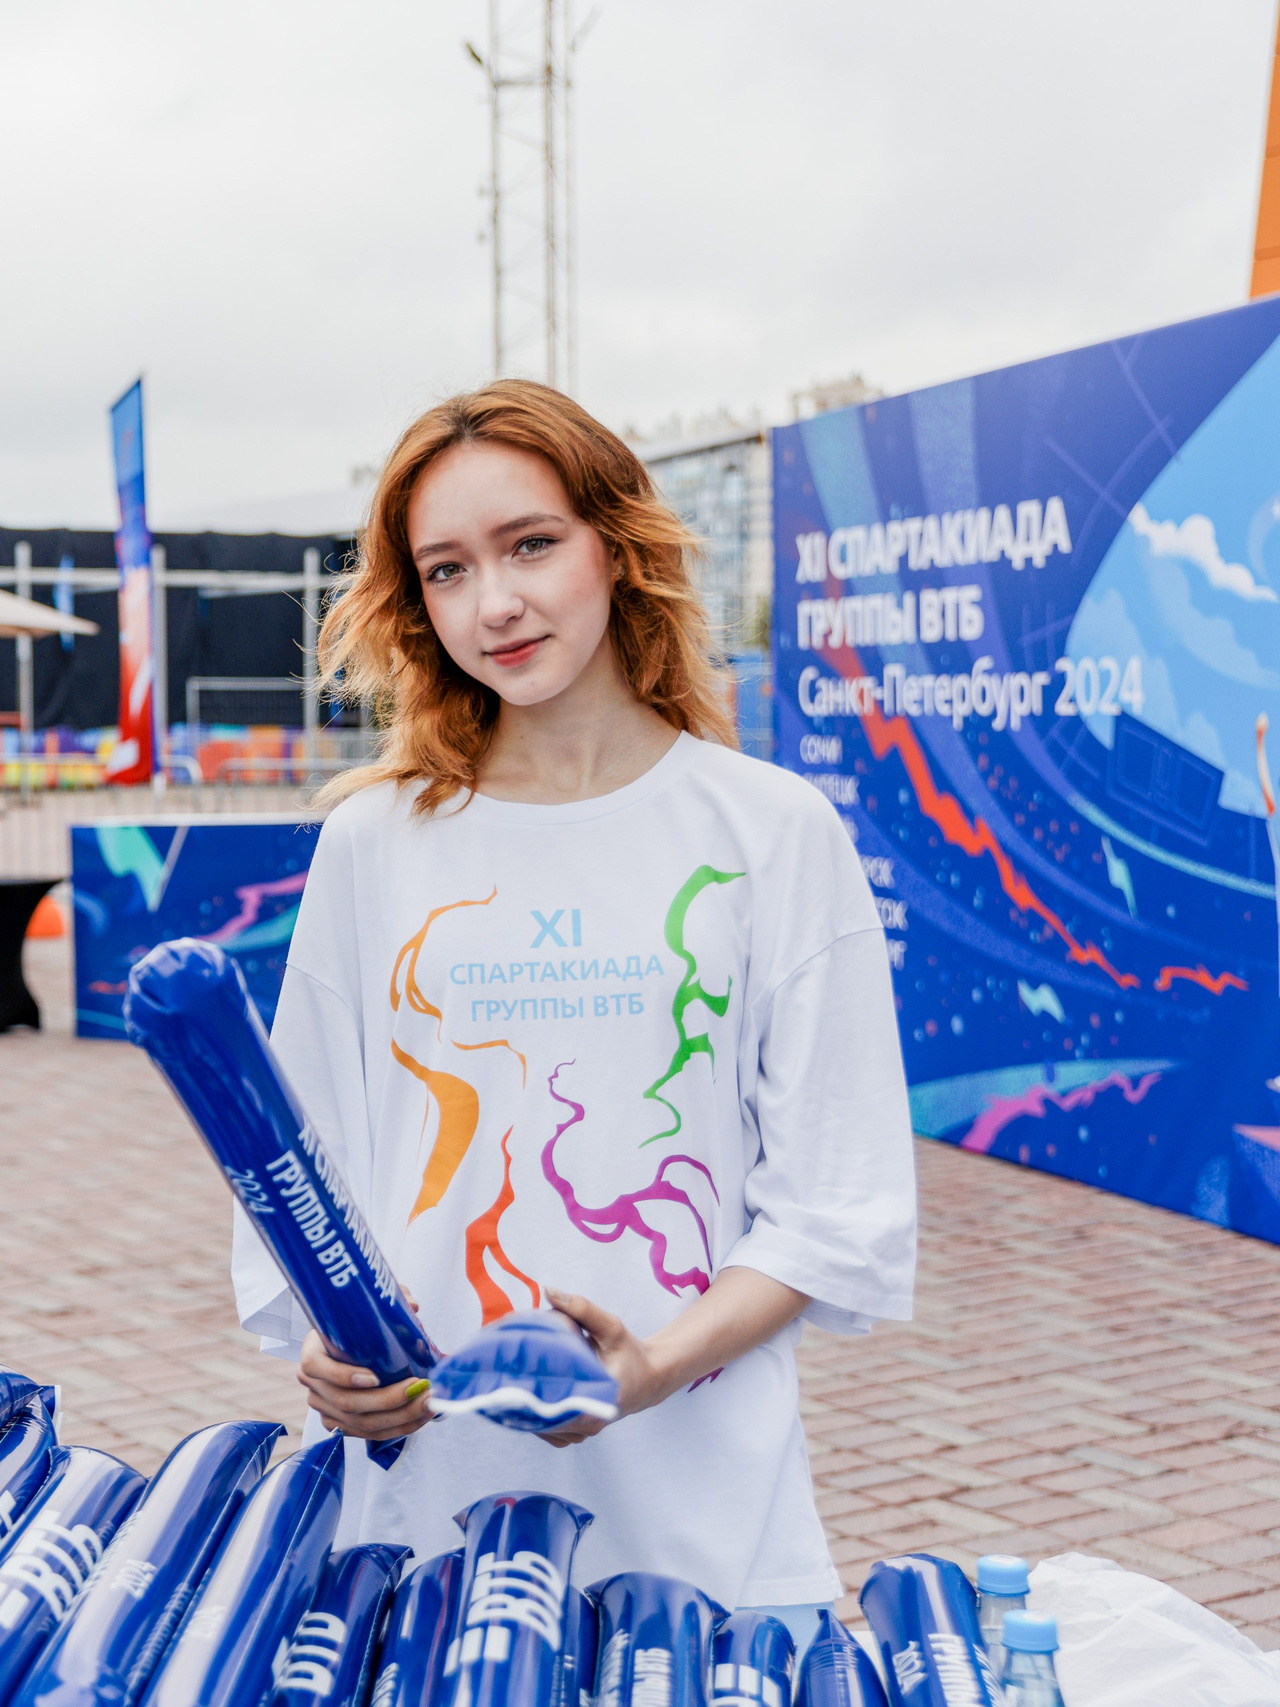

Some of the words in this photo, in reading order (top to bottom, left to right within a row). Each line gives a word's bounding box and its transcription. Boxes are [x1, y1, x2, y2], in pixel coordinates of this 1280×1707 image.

[795, 530, 827, 584] XI
[828, 495, 1073, 580] СПАРТАКИАДА
[797, 590, 916, 650] ГРУППЫ
[919, 583, 985, 643] ВТБ
[799, 655, 1052, 733] Санкт-Петербург
[1054, 656, 1145, 717] 2024
[800, 734, 843, 765] СОЧИ
[530, 909, 582, 948] XI
[449, 955, 665, 986] СПАРТАКИАДА
[471, 998, 584, 1022] ГРУППЫ
[593, 993, 645, 1018] ВТБ
[225, 1164, 276, 1214] 2024
[265, 1149, 337, 1249] ГРУППЫ
[317, 1240, 359, 1288] ВТБ
[465, 1550, 563, 1652] ВТБ
